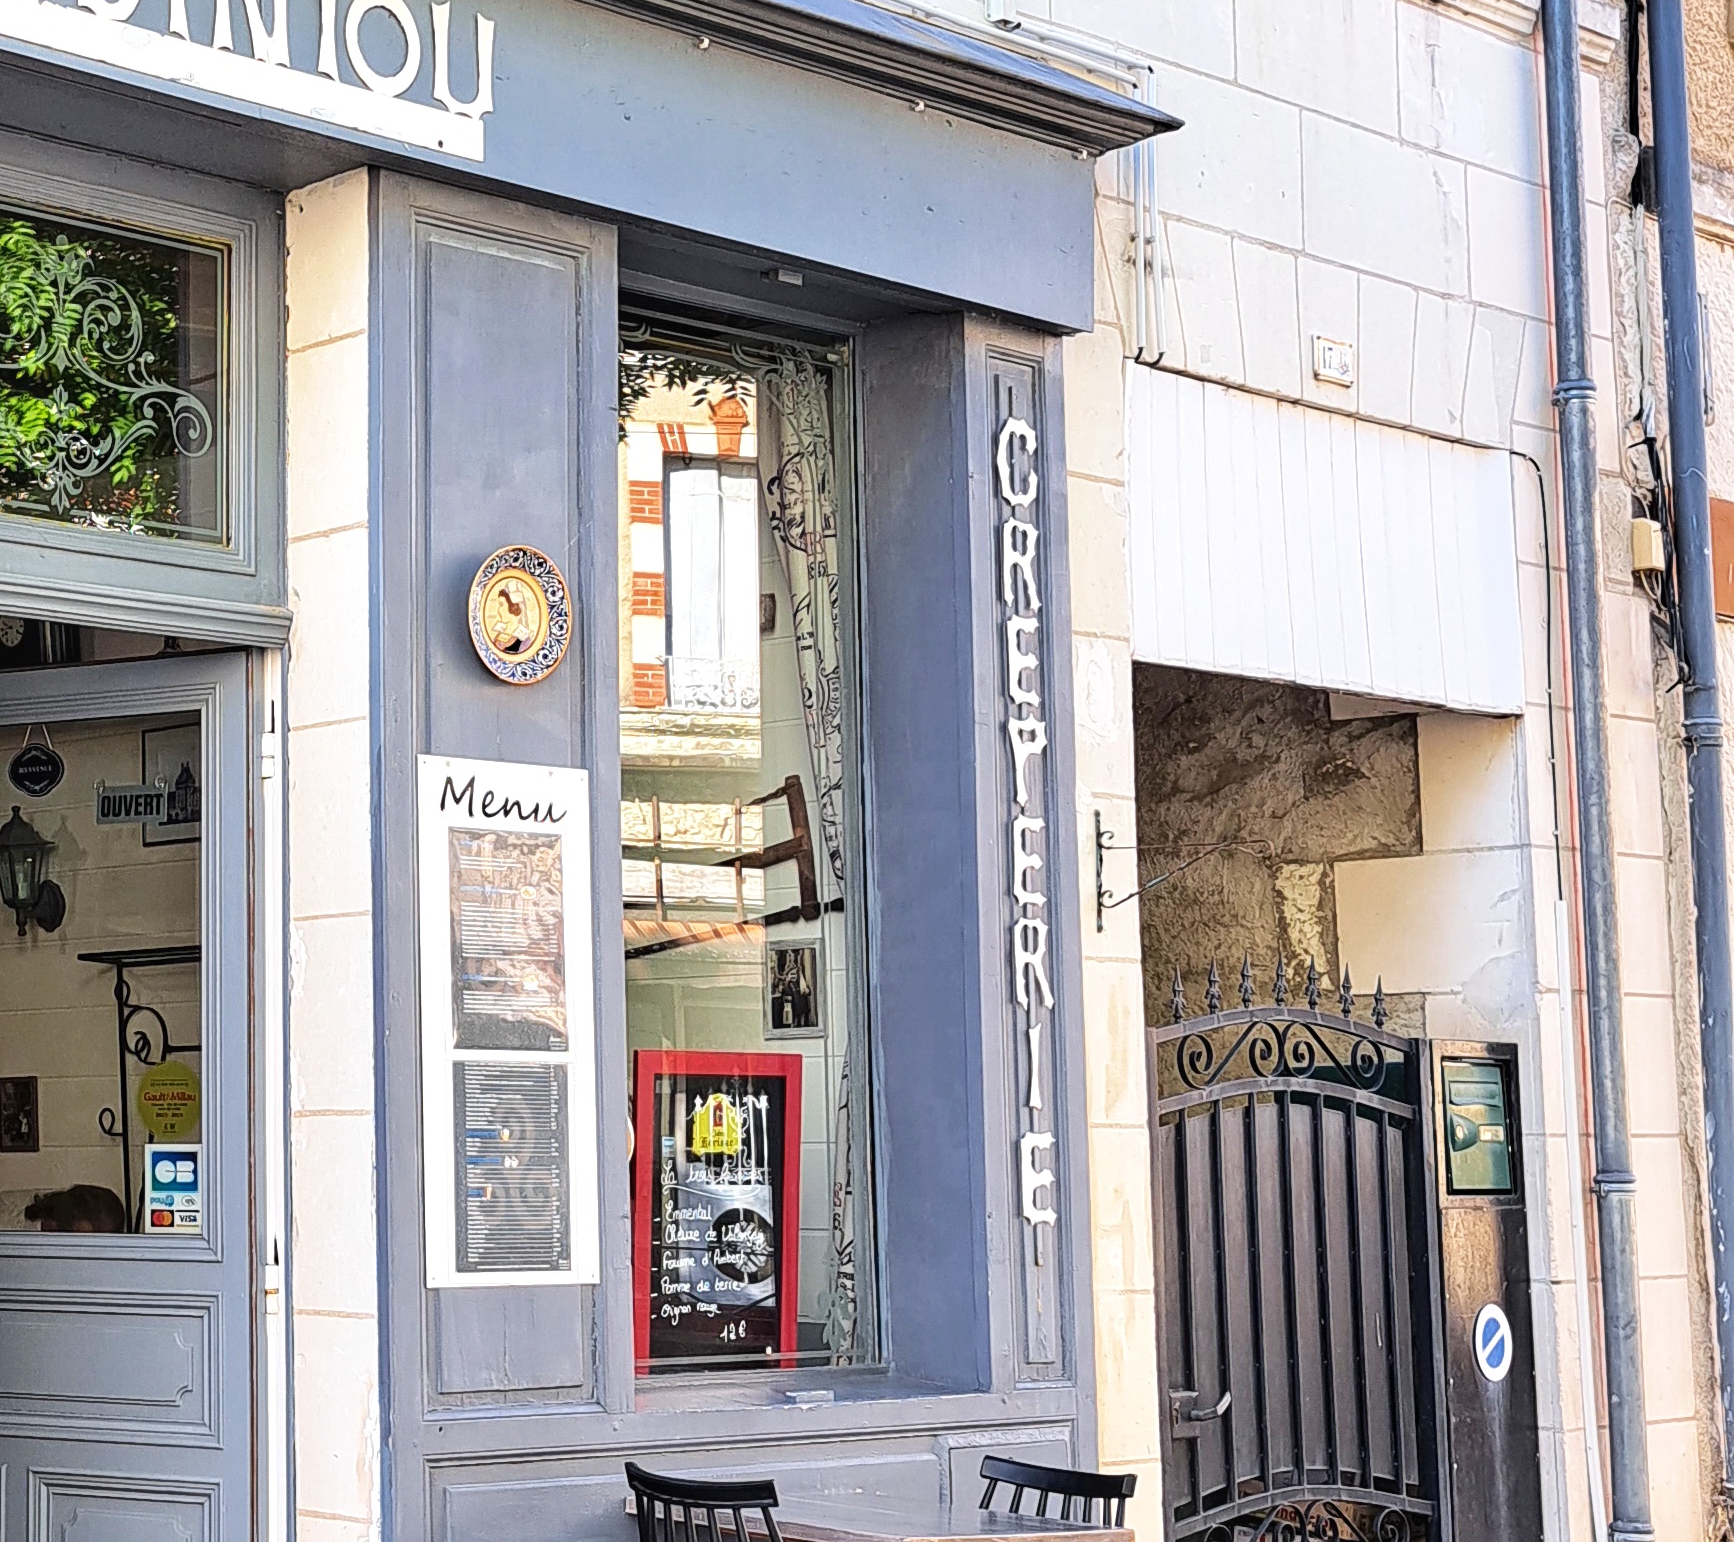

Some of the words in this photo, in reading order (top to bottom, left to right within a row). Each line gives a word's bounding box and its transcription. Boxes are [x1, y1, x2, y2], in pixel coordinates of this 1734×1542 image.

[100, 793, 164, 818] OUVERT
[440, 775, 568, 823] Menu
[155, 1160, 195, 1184] CB
[665, 1200, 712, 1220] Emmental
[705, 1227, 717, 1241] de
[663, 1251, 696, 1270] Fourme
[661, 1276, 691, 1295] Pomme
[697, 1279, 710, 1292] de
[714, 1275, 741, 1291] terre
[661, 1304, 692, 1326] Oignon
